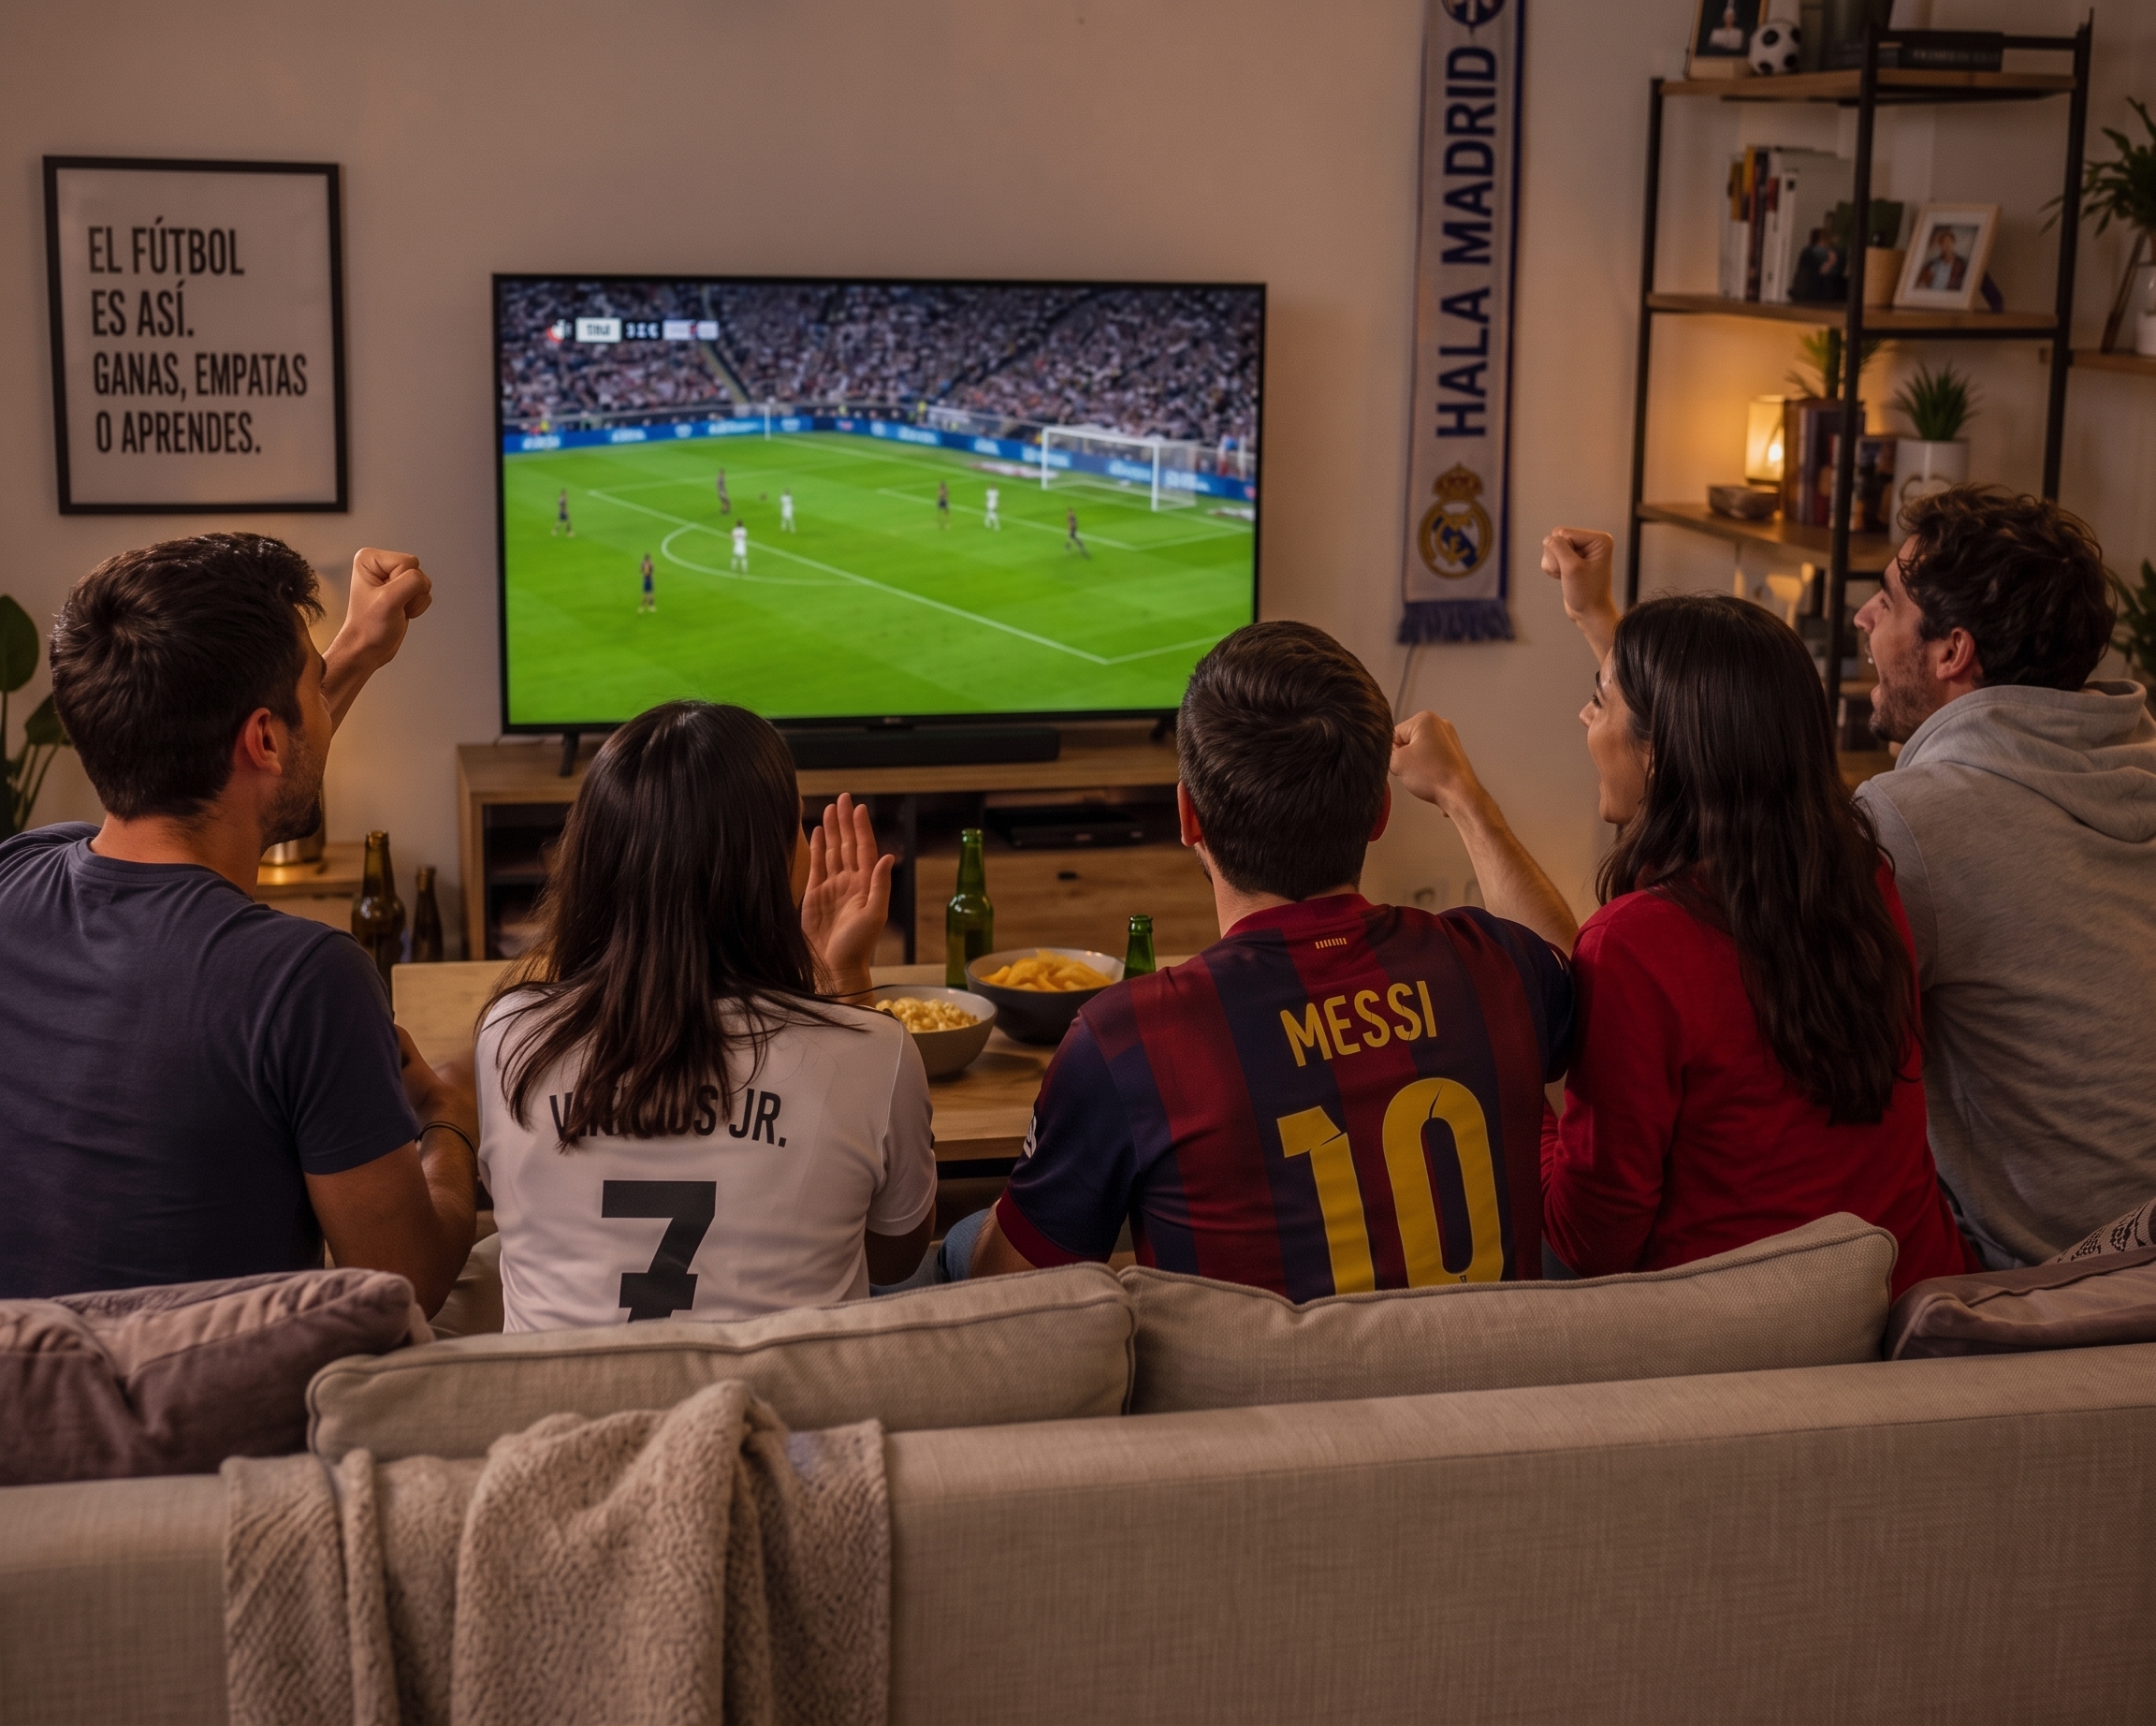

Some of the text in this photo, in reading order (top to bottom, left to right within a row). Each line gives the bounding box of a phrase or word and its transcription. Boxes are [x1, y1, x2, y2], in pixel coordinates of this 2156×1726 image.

[89, 216, 245, 275] EL FÚTBOL
[1435, 45, 1497, 438] HALA MADRID
[92, 280, 195, 337] ES ASÍ.
[94, 352, 308, 402] GANAS, EMPATAS
[96, 411, 261, 454] O APRENDES.
[1279, 980, 1437, 1067] MESSI
[728, 1088, 787, 1148] JR.
[1276, 1077, 1504, 1295] 10
[602, 1179, 717, 1323] 7
